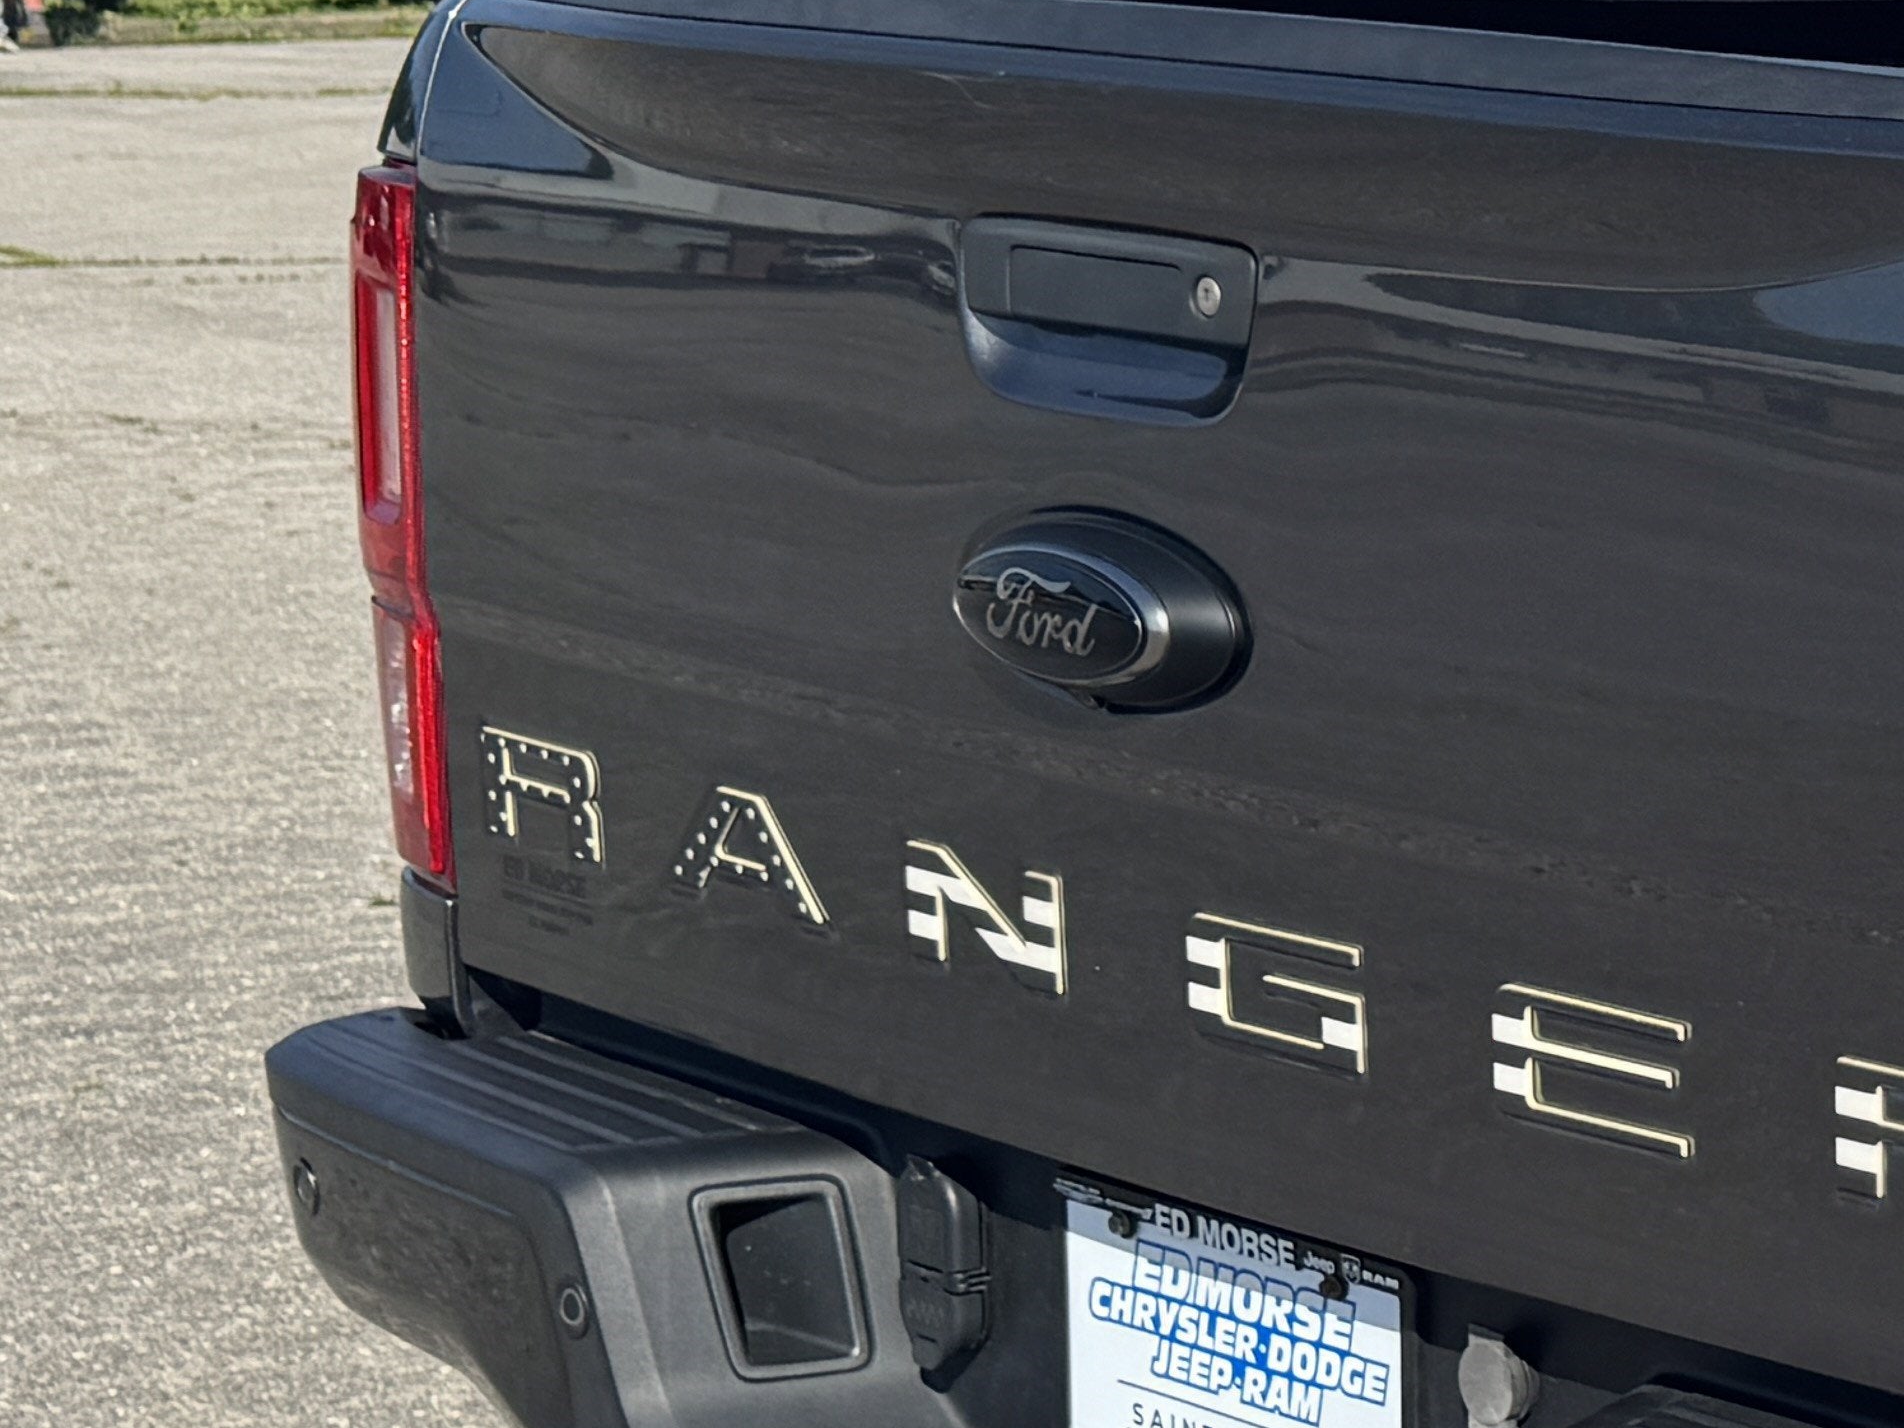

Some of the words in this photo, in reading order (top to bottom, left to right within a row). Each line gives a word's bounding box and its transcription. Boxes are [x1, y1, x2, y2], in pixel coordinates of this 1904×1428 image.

[986, 566, 1099, 656] Ford
[1154, 1202, 1190, 1239] ED
[1197, 1215, 1295, 1271] MORSE
[1132, 1239, 1192, 1300] ED
[1196, 1257, 1356, 1350] MORSE
